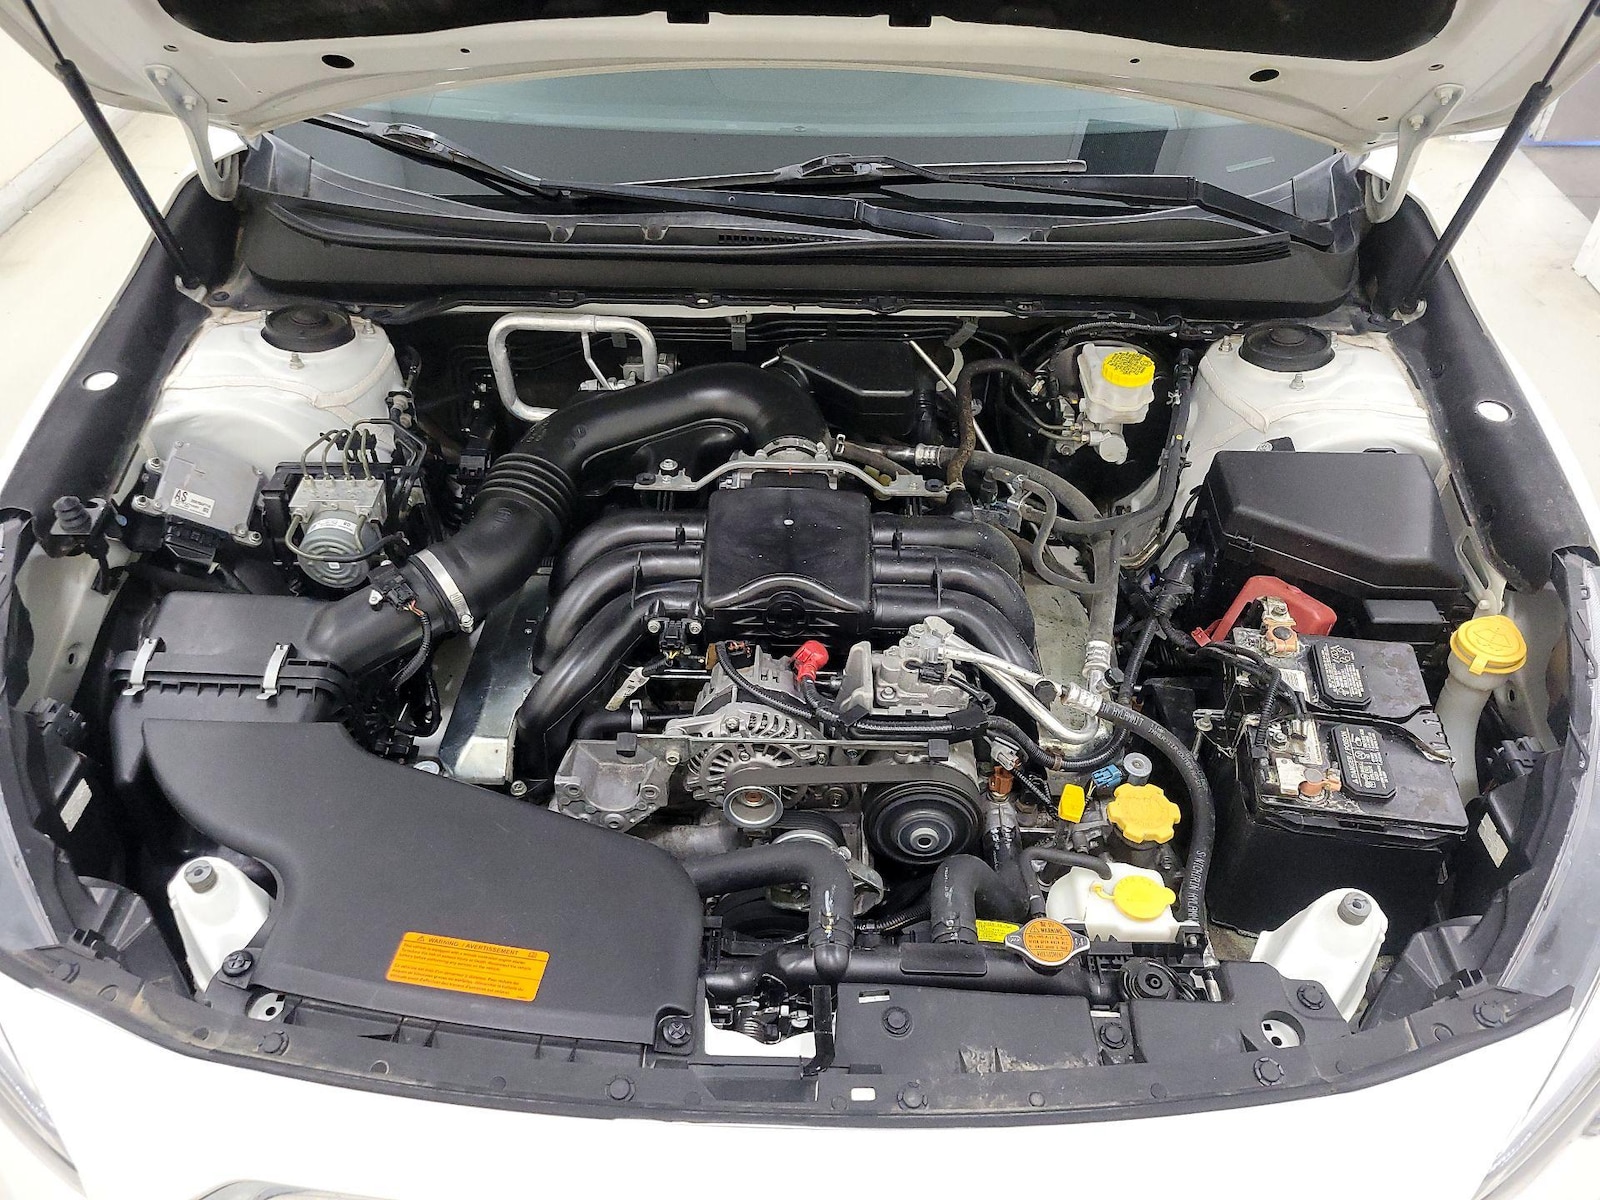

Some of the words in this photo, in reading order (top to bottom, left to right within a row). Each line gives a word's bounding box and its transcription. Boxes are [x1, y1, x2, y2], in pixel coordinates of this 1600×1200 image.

[174, 490, 188, 502] AS
[1340, 730, 1351, 750] POISON
[428, 937, 459, 947] WARNING
[465, 943, 519, 956] AVERTISSEMENT
